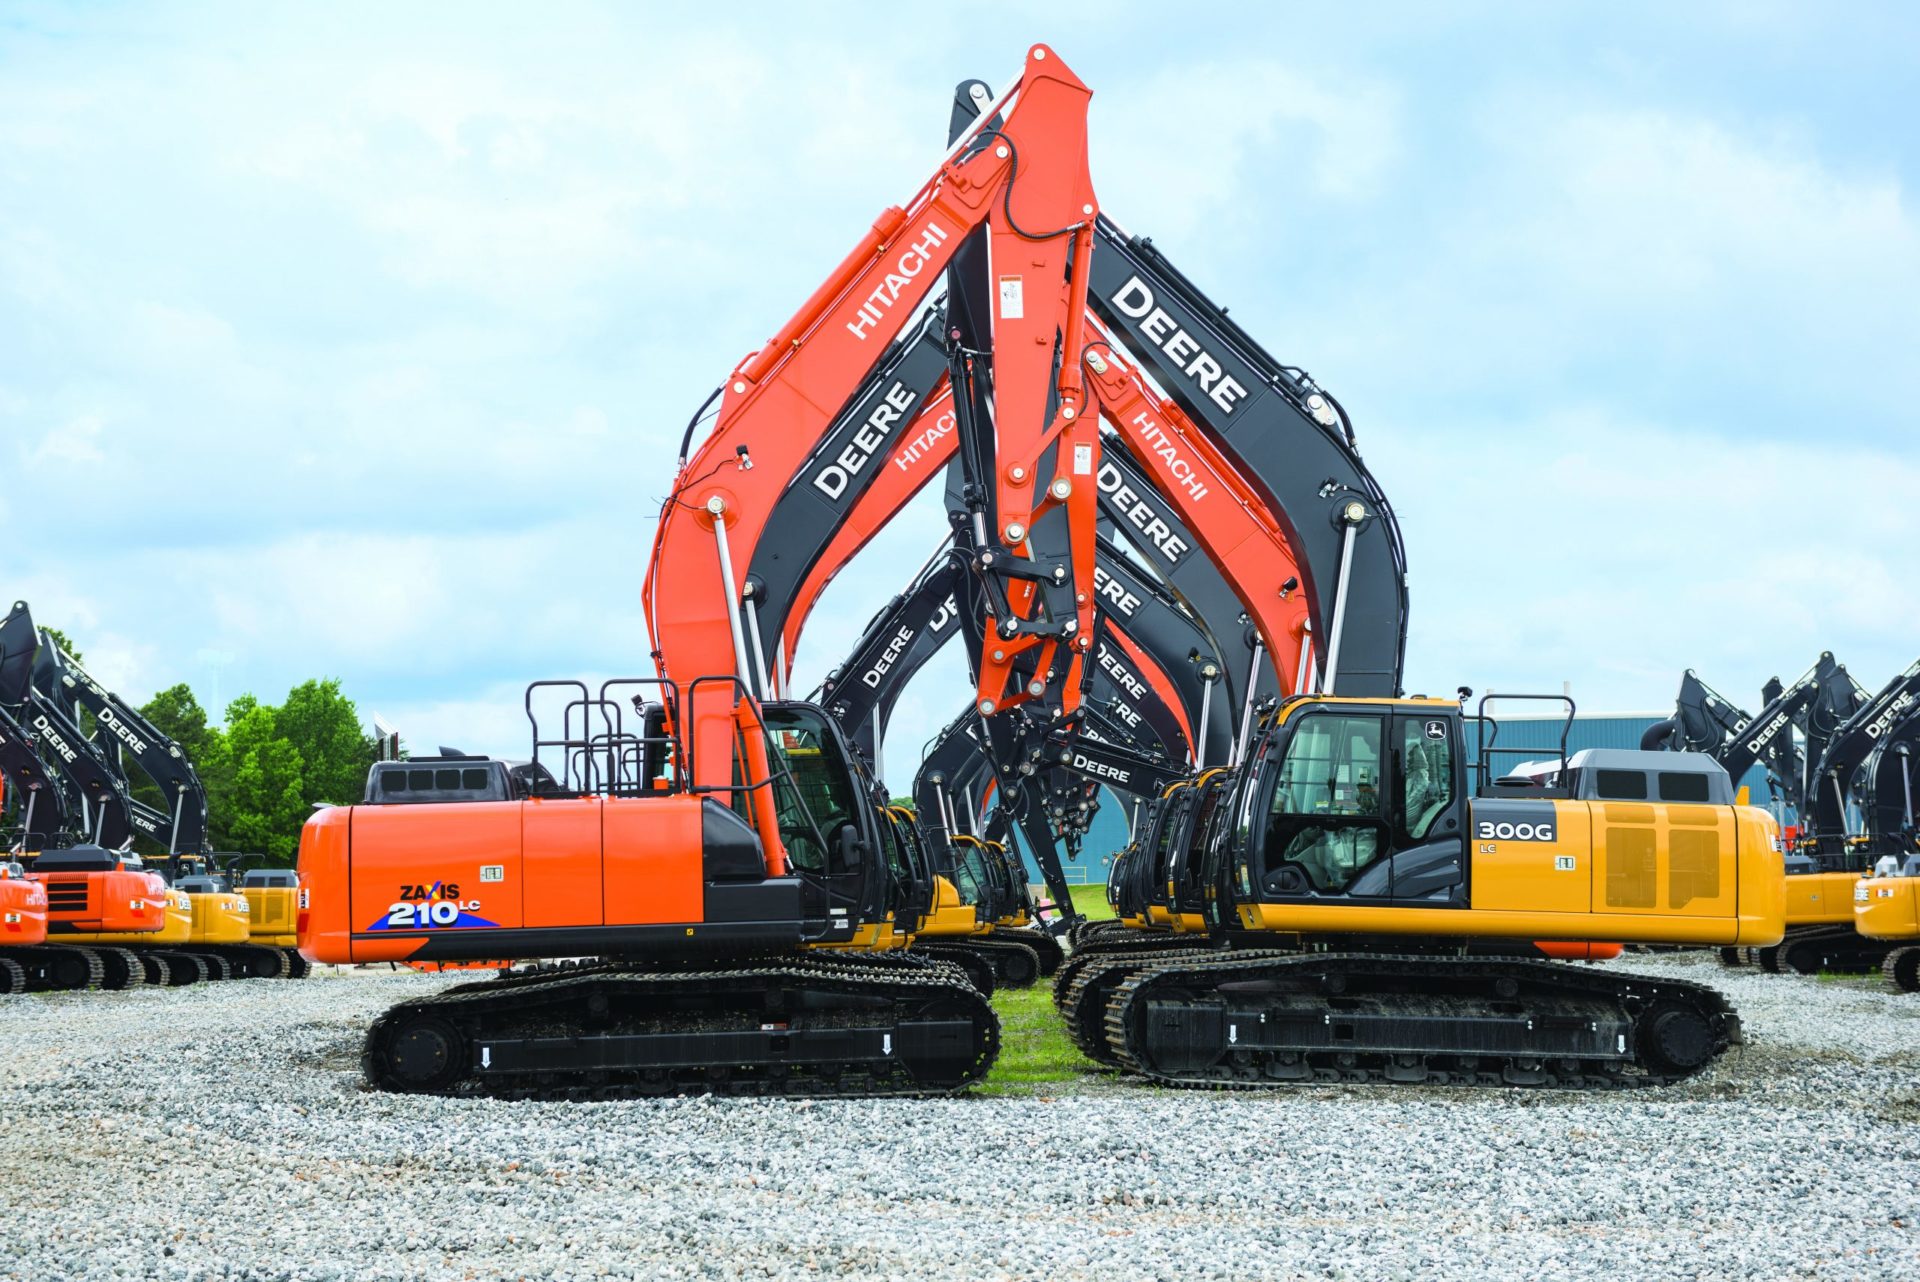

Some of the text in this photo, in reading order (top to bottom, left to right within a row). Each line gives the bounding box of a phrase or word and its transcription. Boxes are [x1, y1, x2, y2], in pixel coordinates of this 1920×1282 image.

[846, 222, 948, 340] HITACHI
[1111, 276, 1248, 414] DEERE
[813, 381, 916, 500] DEERE
[1132, 411, 1208, 502] HITACHI
[1097, 462, 1188, 563] DEERE
[862, 624, 914, 688] DEERE
[33, 714, 78, 763] DEERE
[98, 706, 147, 755] DEERE
[1747, 711, 1789, 754] DEERE
[1073, 754, 1130, 783] DEERE
[1479, 821, 1553, 841] 300G
[1480, 844, 1496, 853] LC
[388, 900, 481, 929] 210 LC
[400, 880, 460, 901] ZAXIS
